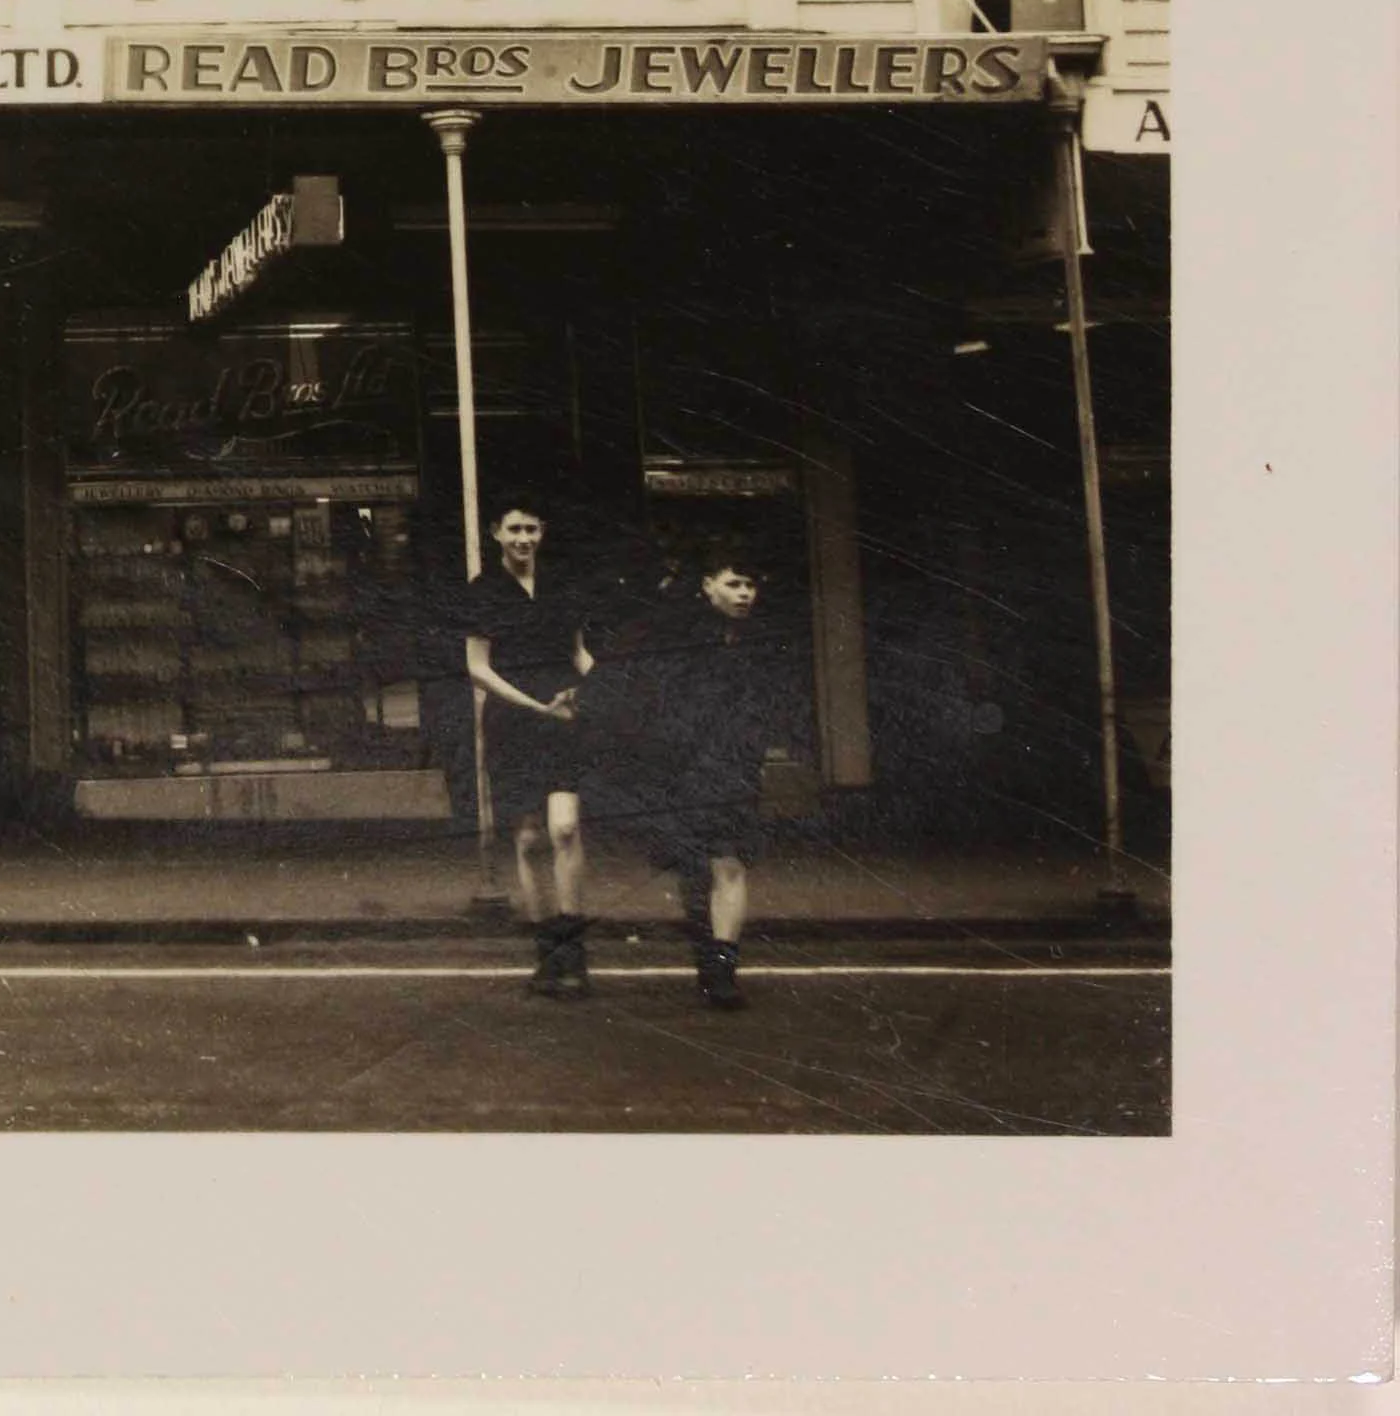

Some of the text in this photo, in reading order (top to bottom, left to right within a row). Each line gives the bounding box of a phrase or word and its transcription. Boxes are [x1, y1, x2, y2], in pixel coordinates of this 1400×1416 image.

[126, 42, 338, 95] READ
[566, 42, 1023, 96] JEWELLERS
[1136, 99, 1171, 142] A
